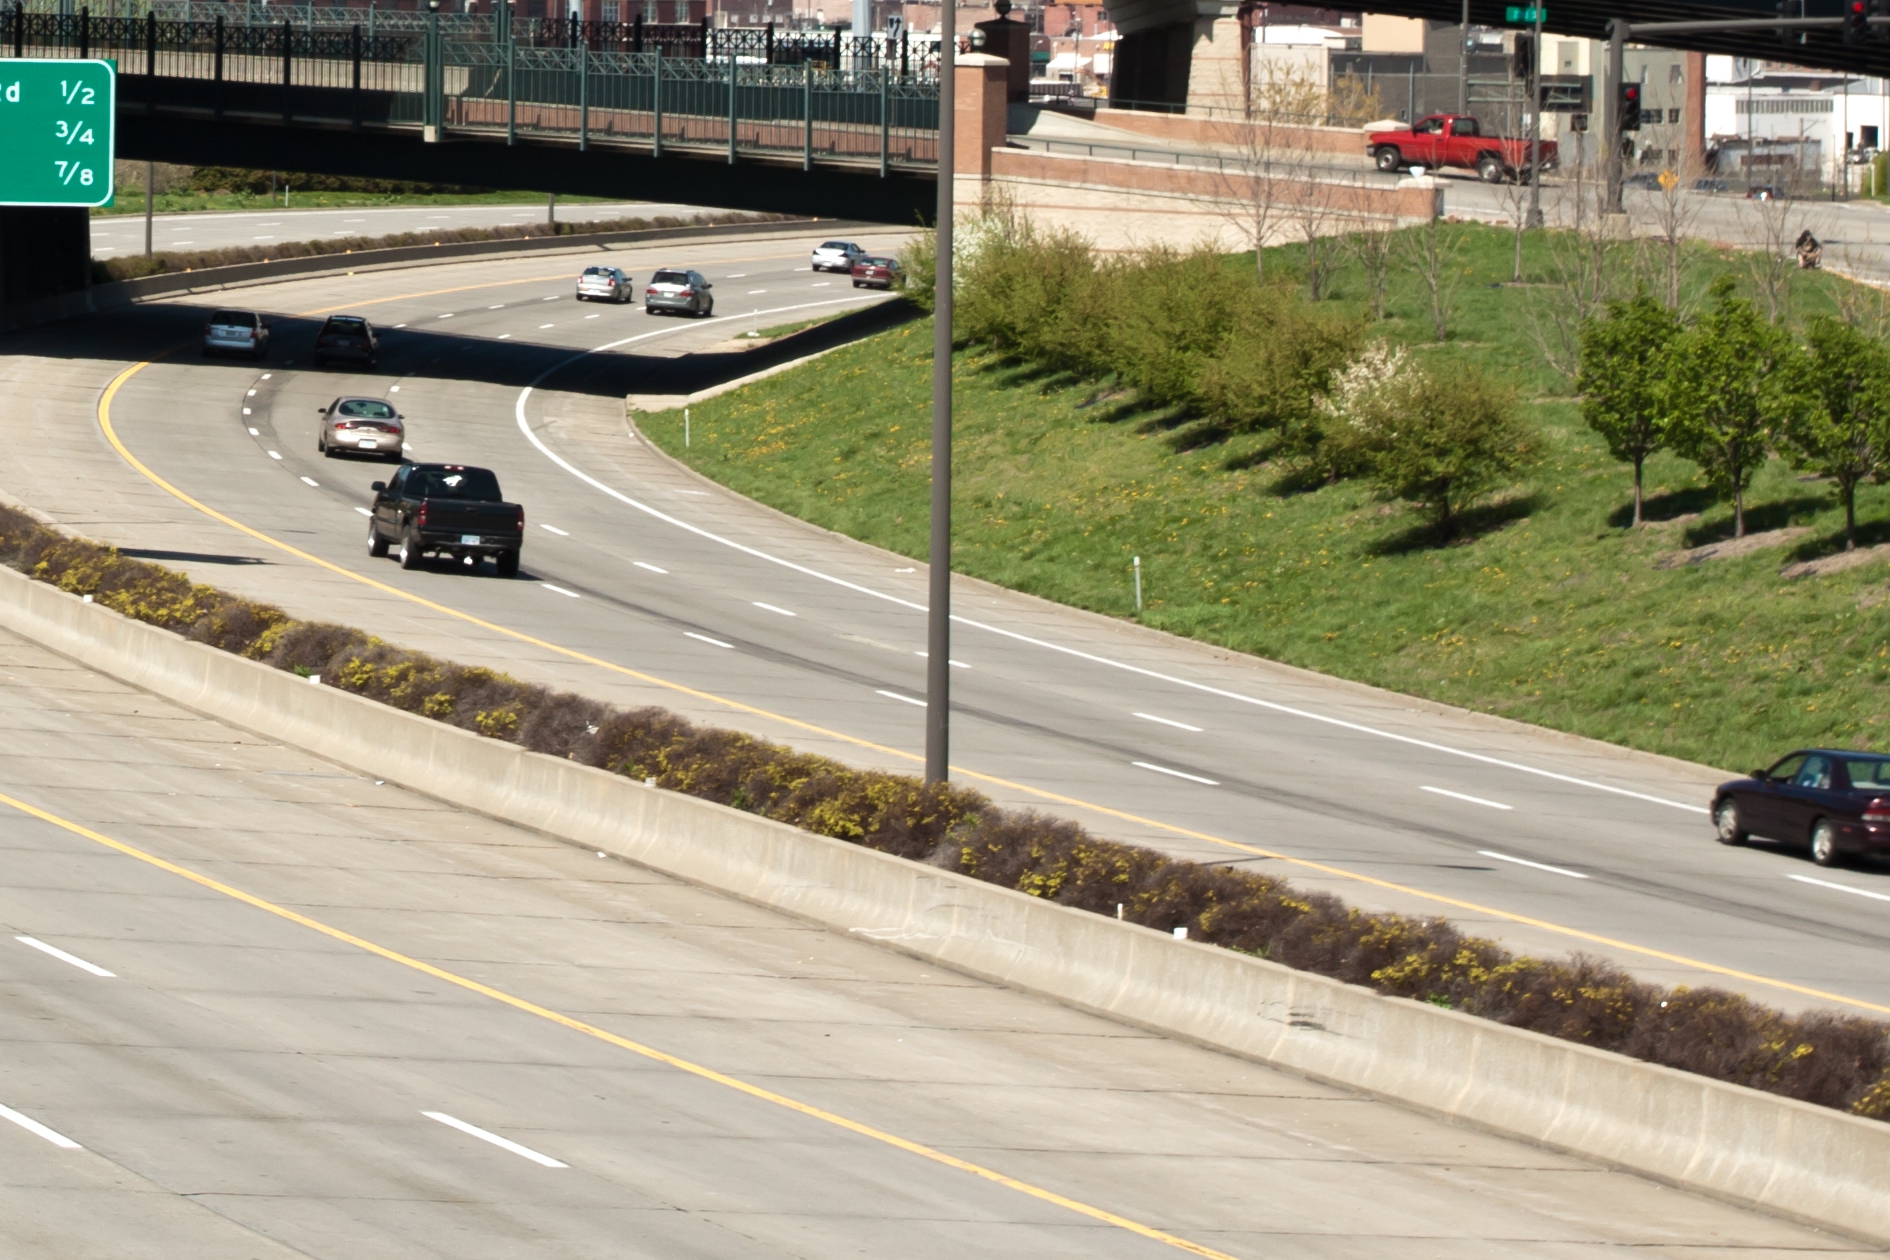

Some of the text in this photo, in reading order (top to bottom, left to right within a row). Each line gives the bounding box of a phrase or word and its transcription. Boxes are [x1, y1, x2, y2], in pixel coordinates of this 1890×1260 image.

[61, 81, 95, 104] 1/2
[56, 121, 94, 144] 3/4
[55, 161, 93, 185] 7/8
